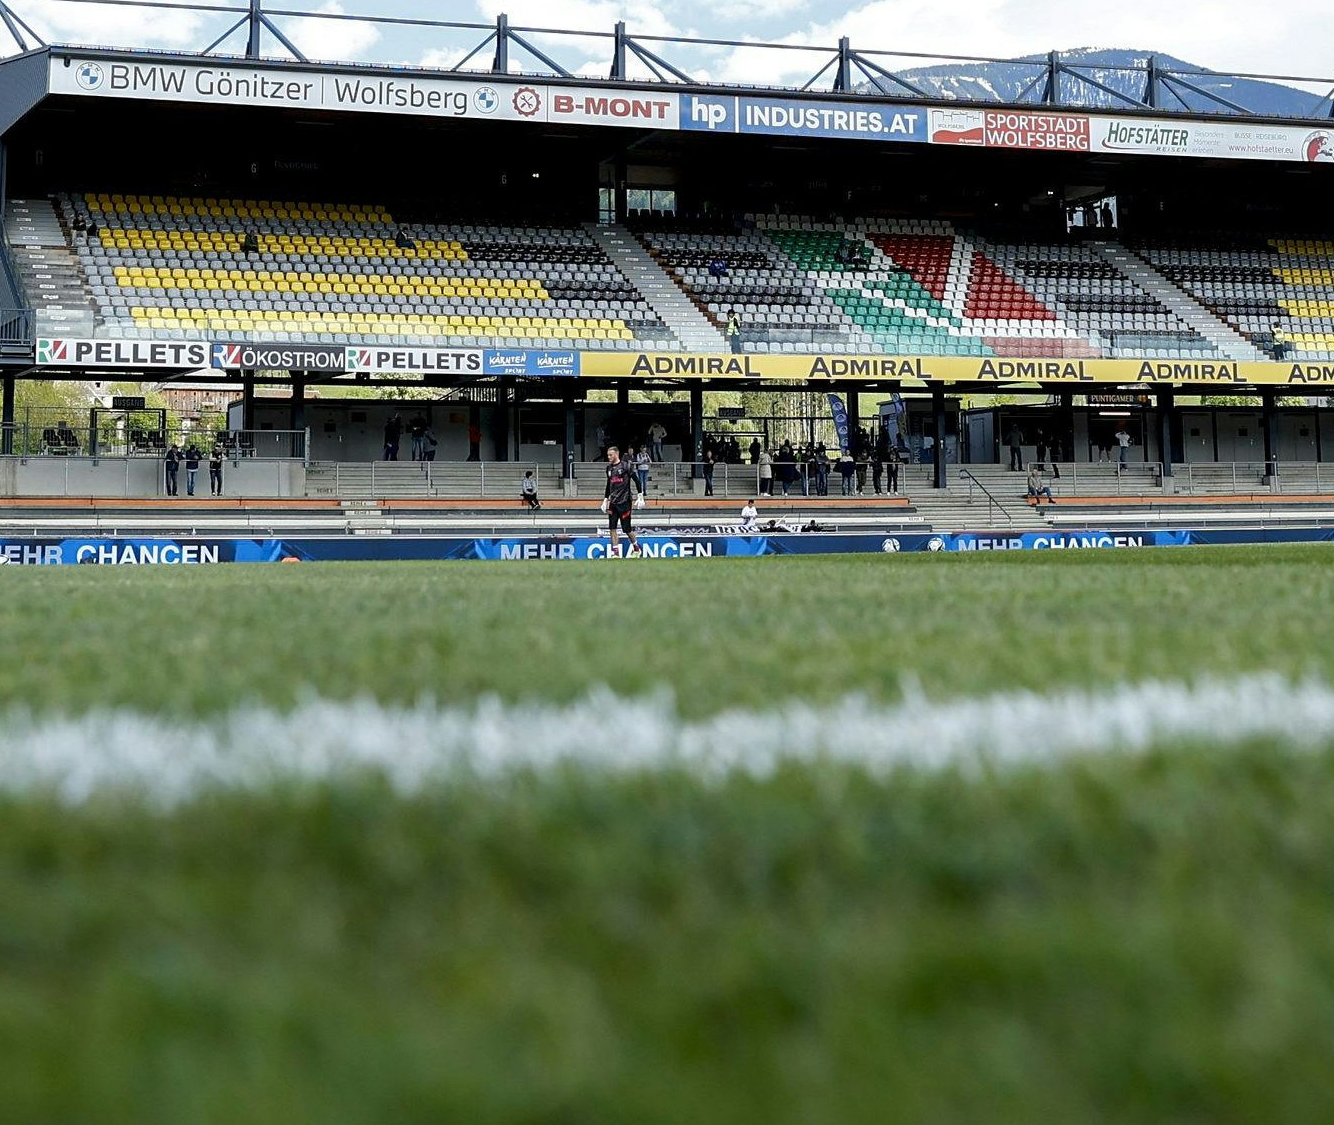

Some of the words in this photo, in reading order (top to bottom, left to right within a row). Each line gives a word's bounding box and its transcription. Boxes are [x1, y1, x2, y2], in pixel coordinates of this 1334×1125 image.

[110, 65, 186, 93] BMW
[195, 69, 313, 101] Gönitzer
[335, 78, 467, 115] Wolfsberg
[554, 95, 670, 119] B-MONT
[691, 97, 727, 130] hp
[746, 105, 918, 134] INDUSTRIES.AT
[987, 113, 1087, 133] SPORTSTADT
[987, 129, 1088, 150] WOLFSBERG
[1107, 122, 1189, 146] HOFSTÄTTER
[1229, 145, 1294, 155] www.hofstaetter.eu
[76, 342, 205, 364] PELLETS
[242, 347, 344, 368] ÖKOSTROM
[377, 352, 481, 370] PELLETS
[631, 354, 761, 377] ADMIRAL
[809, 357, 932, 379] ADMIRAL
[977, 359, 1094, 381] ADMIRAL
[1137, 361, 1247, 382] ADMIRAL
[1091, 394, 1134, 403] PUNTIGAMER
[76, 545, 219, 564] CHANCEN
[500, 544, 575, 559] MEHR
